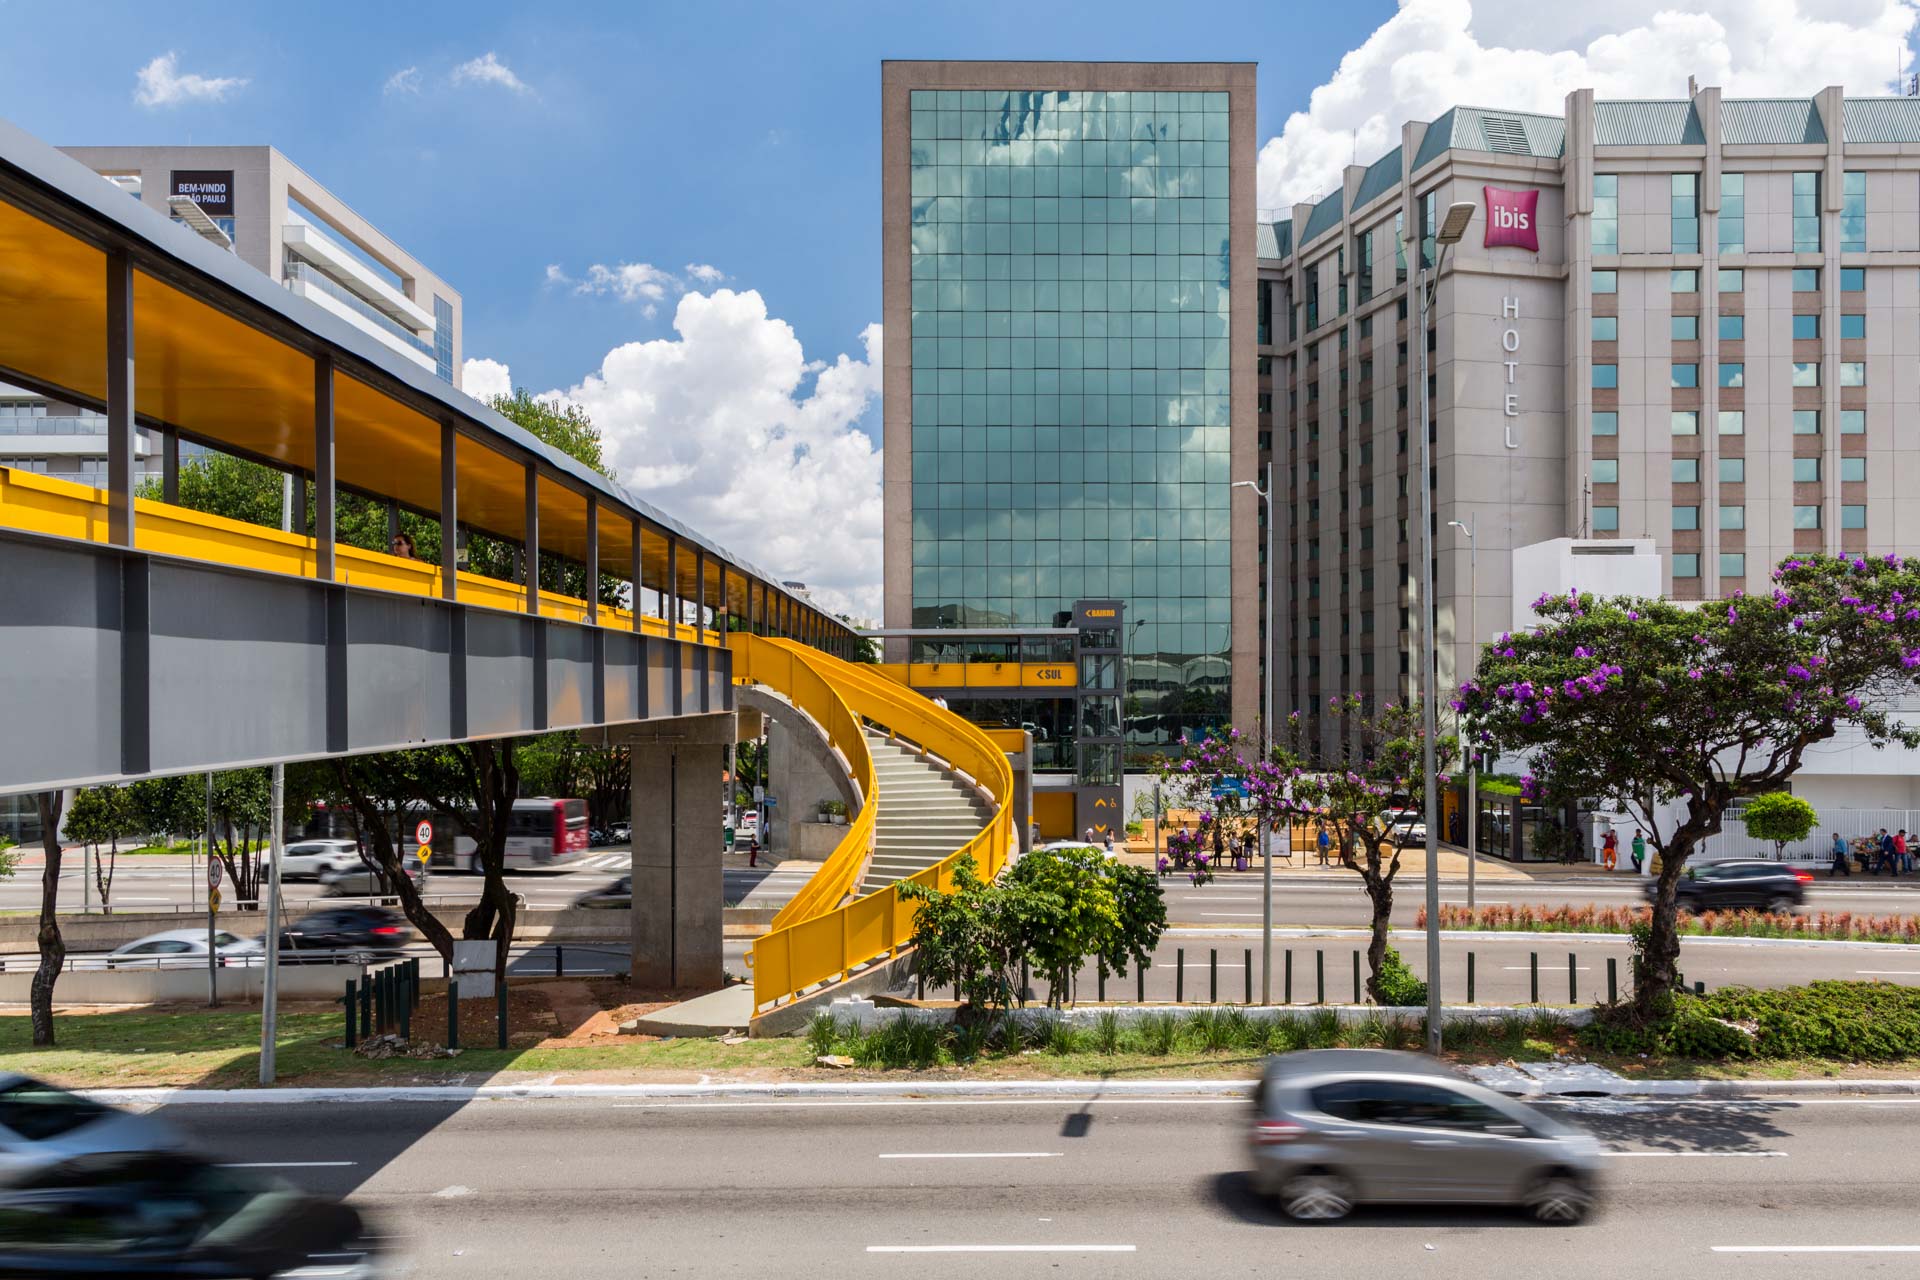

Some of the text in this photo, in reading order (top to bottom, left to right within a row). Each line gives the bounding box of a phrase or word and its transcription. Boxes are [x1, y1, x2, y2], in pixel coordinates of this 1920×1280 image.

[178, 183, 226, 193] BEM-VINDO
[202, 194, 226, 203] PAULO
[1494, 205, 1529, 230] ibis
[1502, 296, 1520, 449] HOTEL
[1045, 669, 1062, 679] SUL
[420, 827, 430, 838] 40
[211, 864, 219, 879] 40
